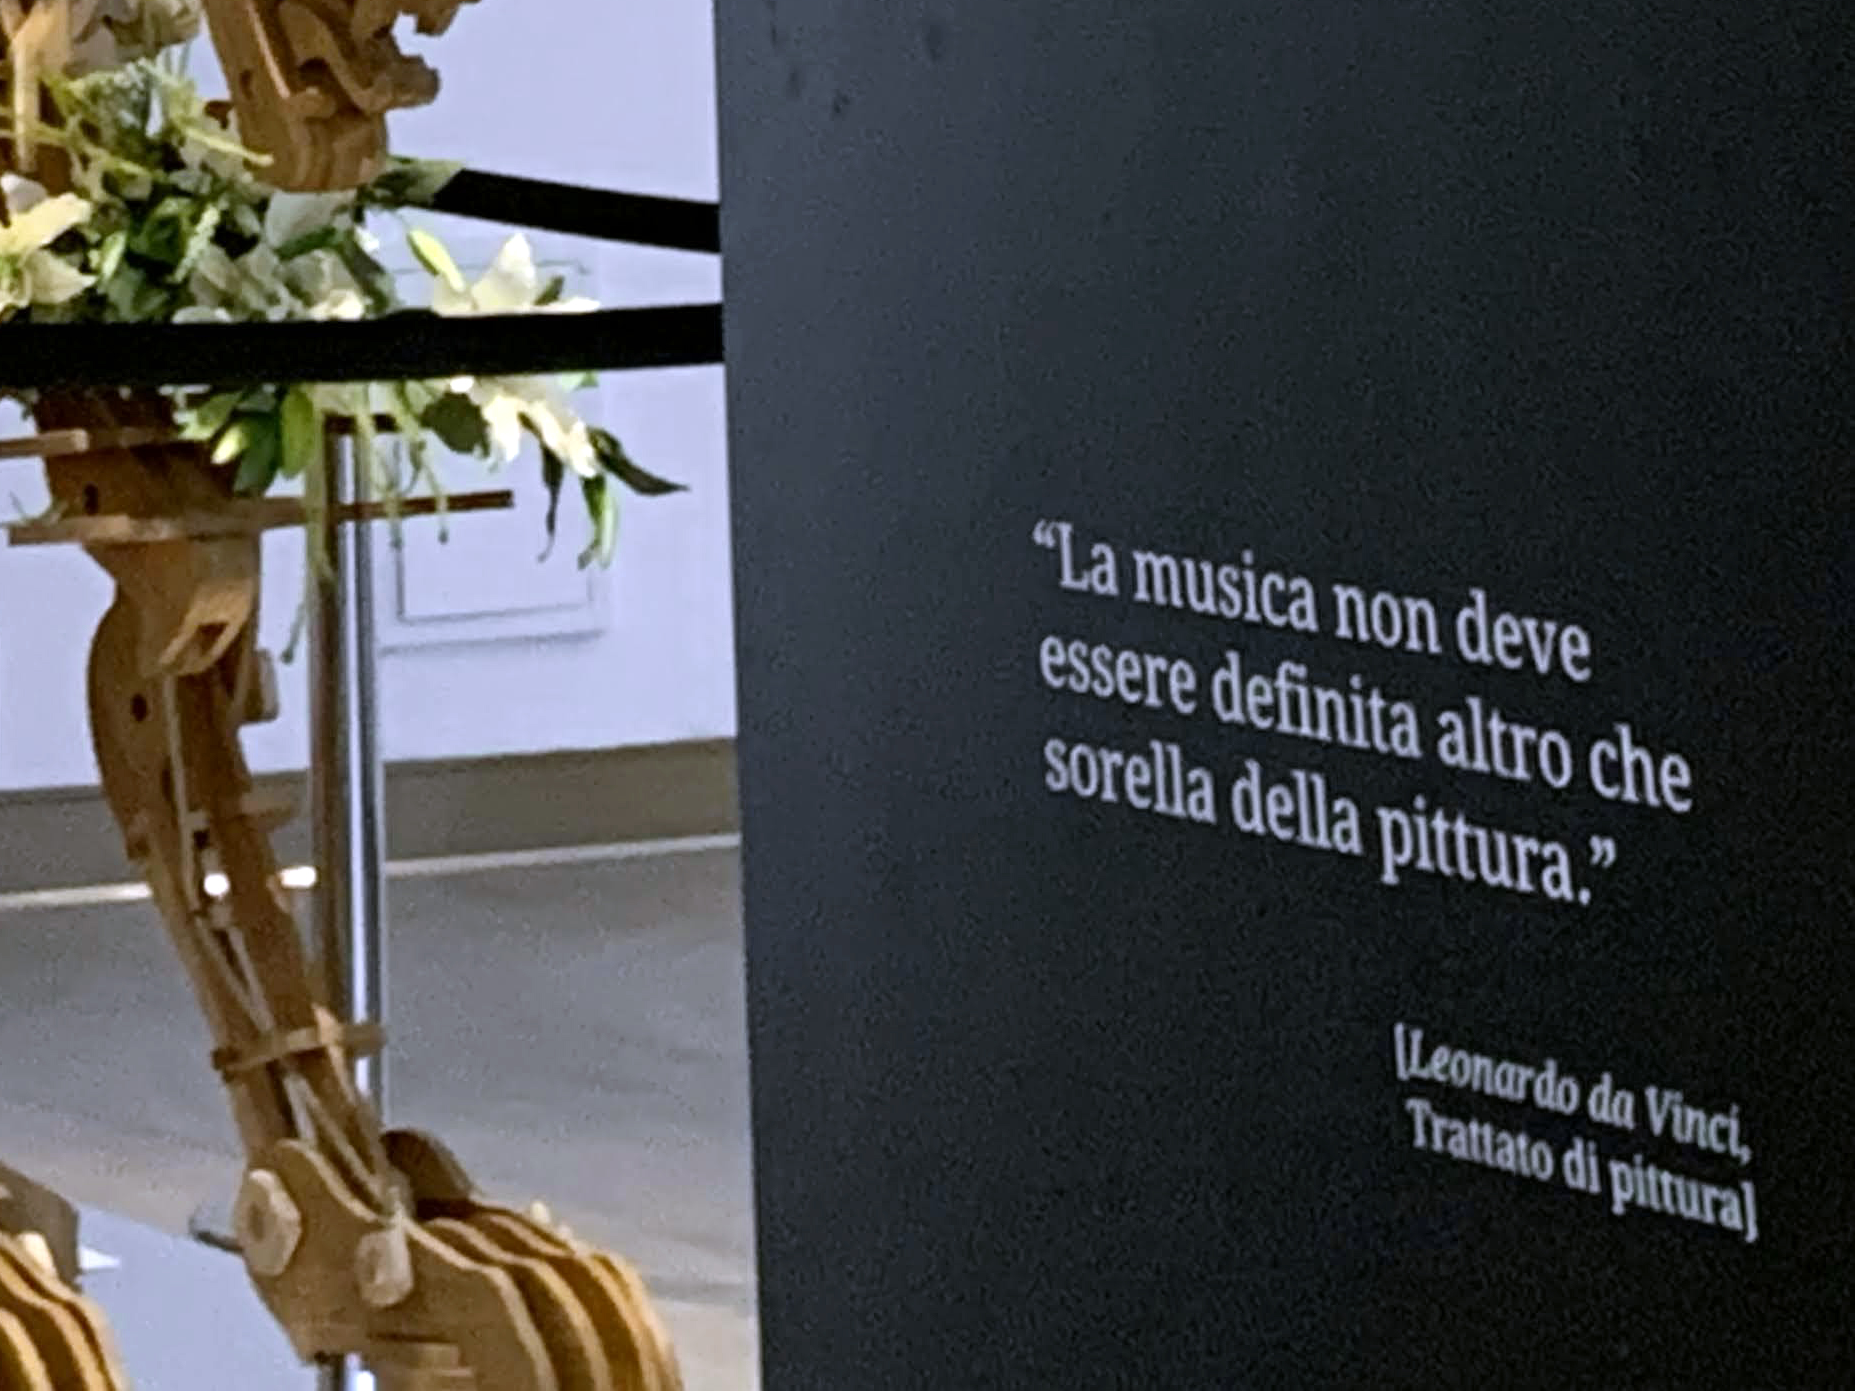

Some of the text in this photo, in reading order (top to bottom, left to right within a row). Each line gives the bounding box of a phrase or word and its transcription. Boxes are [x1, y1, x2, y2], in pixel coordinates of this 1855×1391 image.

[1133, 550, 1318, 633] musica
[1333, 583, 1442, 654] non
[1456, 589, 1592, 682] deve
[1040, 633, 1693, 812] essere definita altro che
[1044, 736, 1217, 825] sorella
[1232, 760, 1364, 857] della
[1405, 1097, 1758, 1244] Trattato di pittura]
[1587, 1072, 1635, 1130] da
[1645, 1085, 1752, 1165] Vinci,
